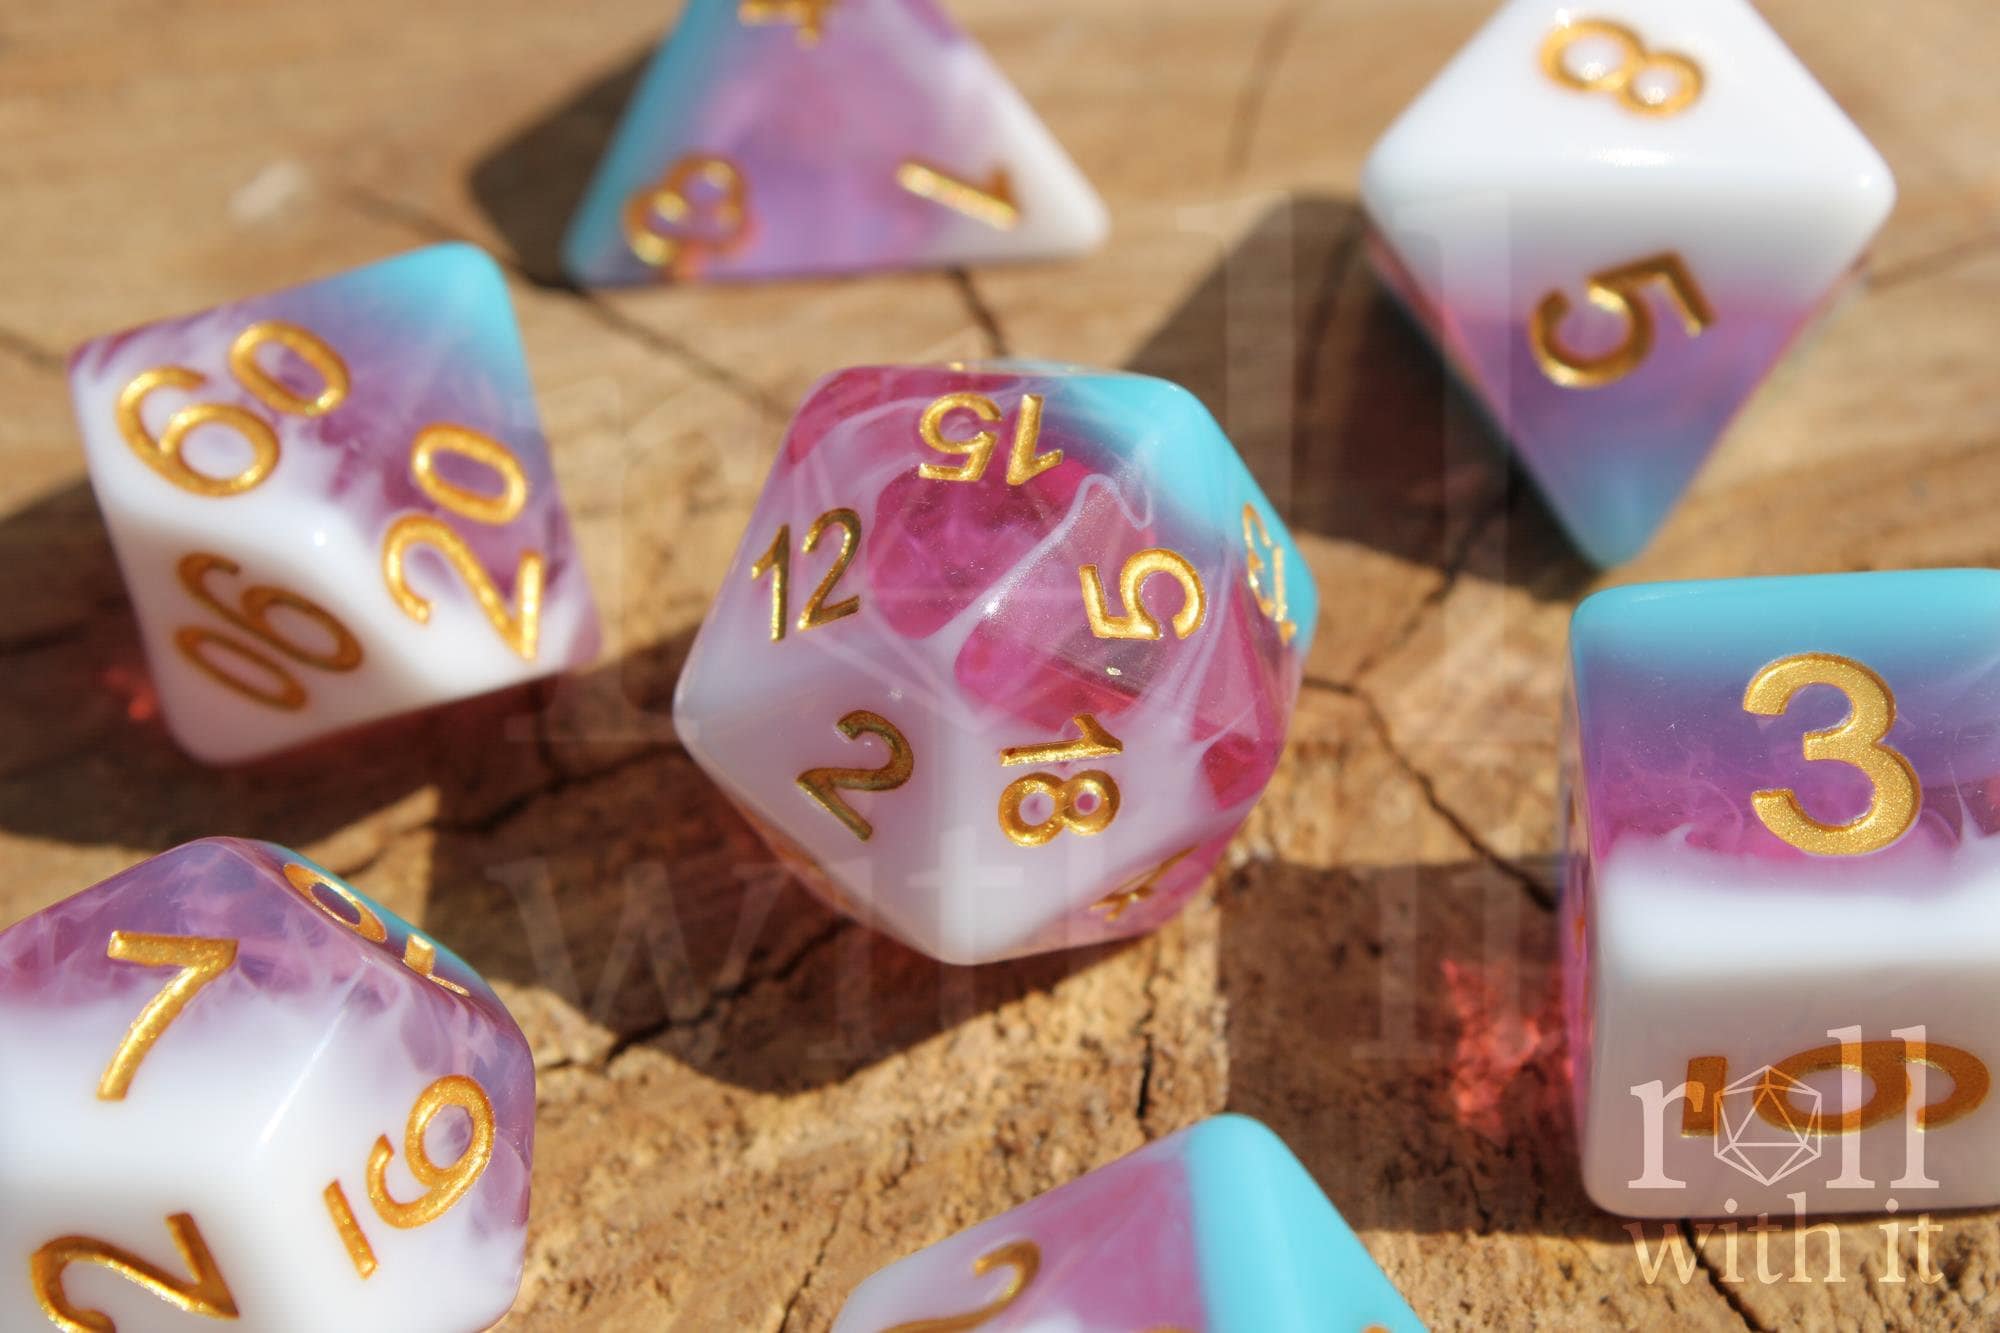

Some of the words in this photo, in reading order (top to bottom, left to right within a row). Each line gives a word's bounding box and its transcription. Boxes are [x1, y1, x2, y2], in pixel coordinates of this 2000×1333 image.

[1538, 18, 1705, 118] 8
[1528, 250, 1718, 388] 5
[115, 320, 352, 497] 60
[918, 391, 1064, 486] 15
[381, 422, 545, 664] 20
[751, 507, 862, 642] 12
[1079, 547, 1207, 642] 5
[796, 709, 914, 842] 2
[998, 713, 1124, 848] 18
[1743, 651, 1922, 857] 3
[96, 930, 239, 1101] 7
